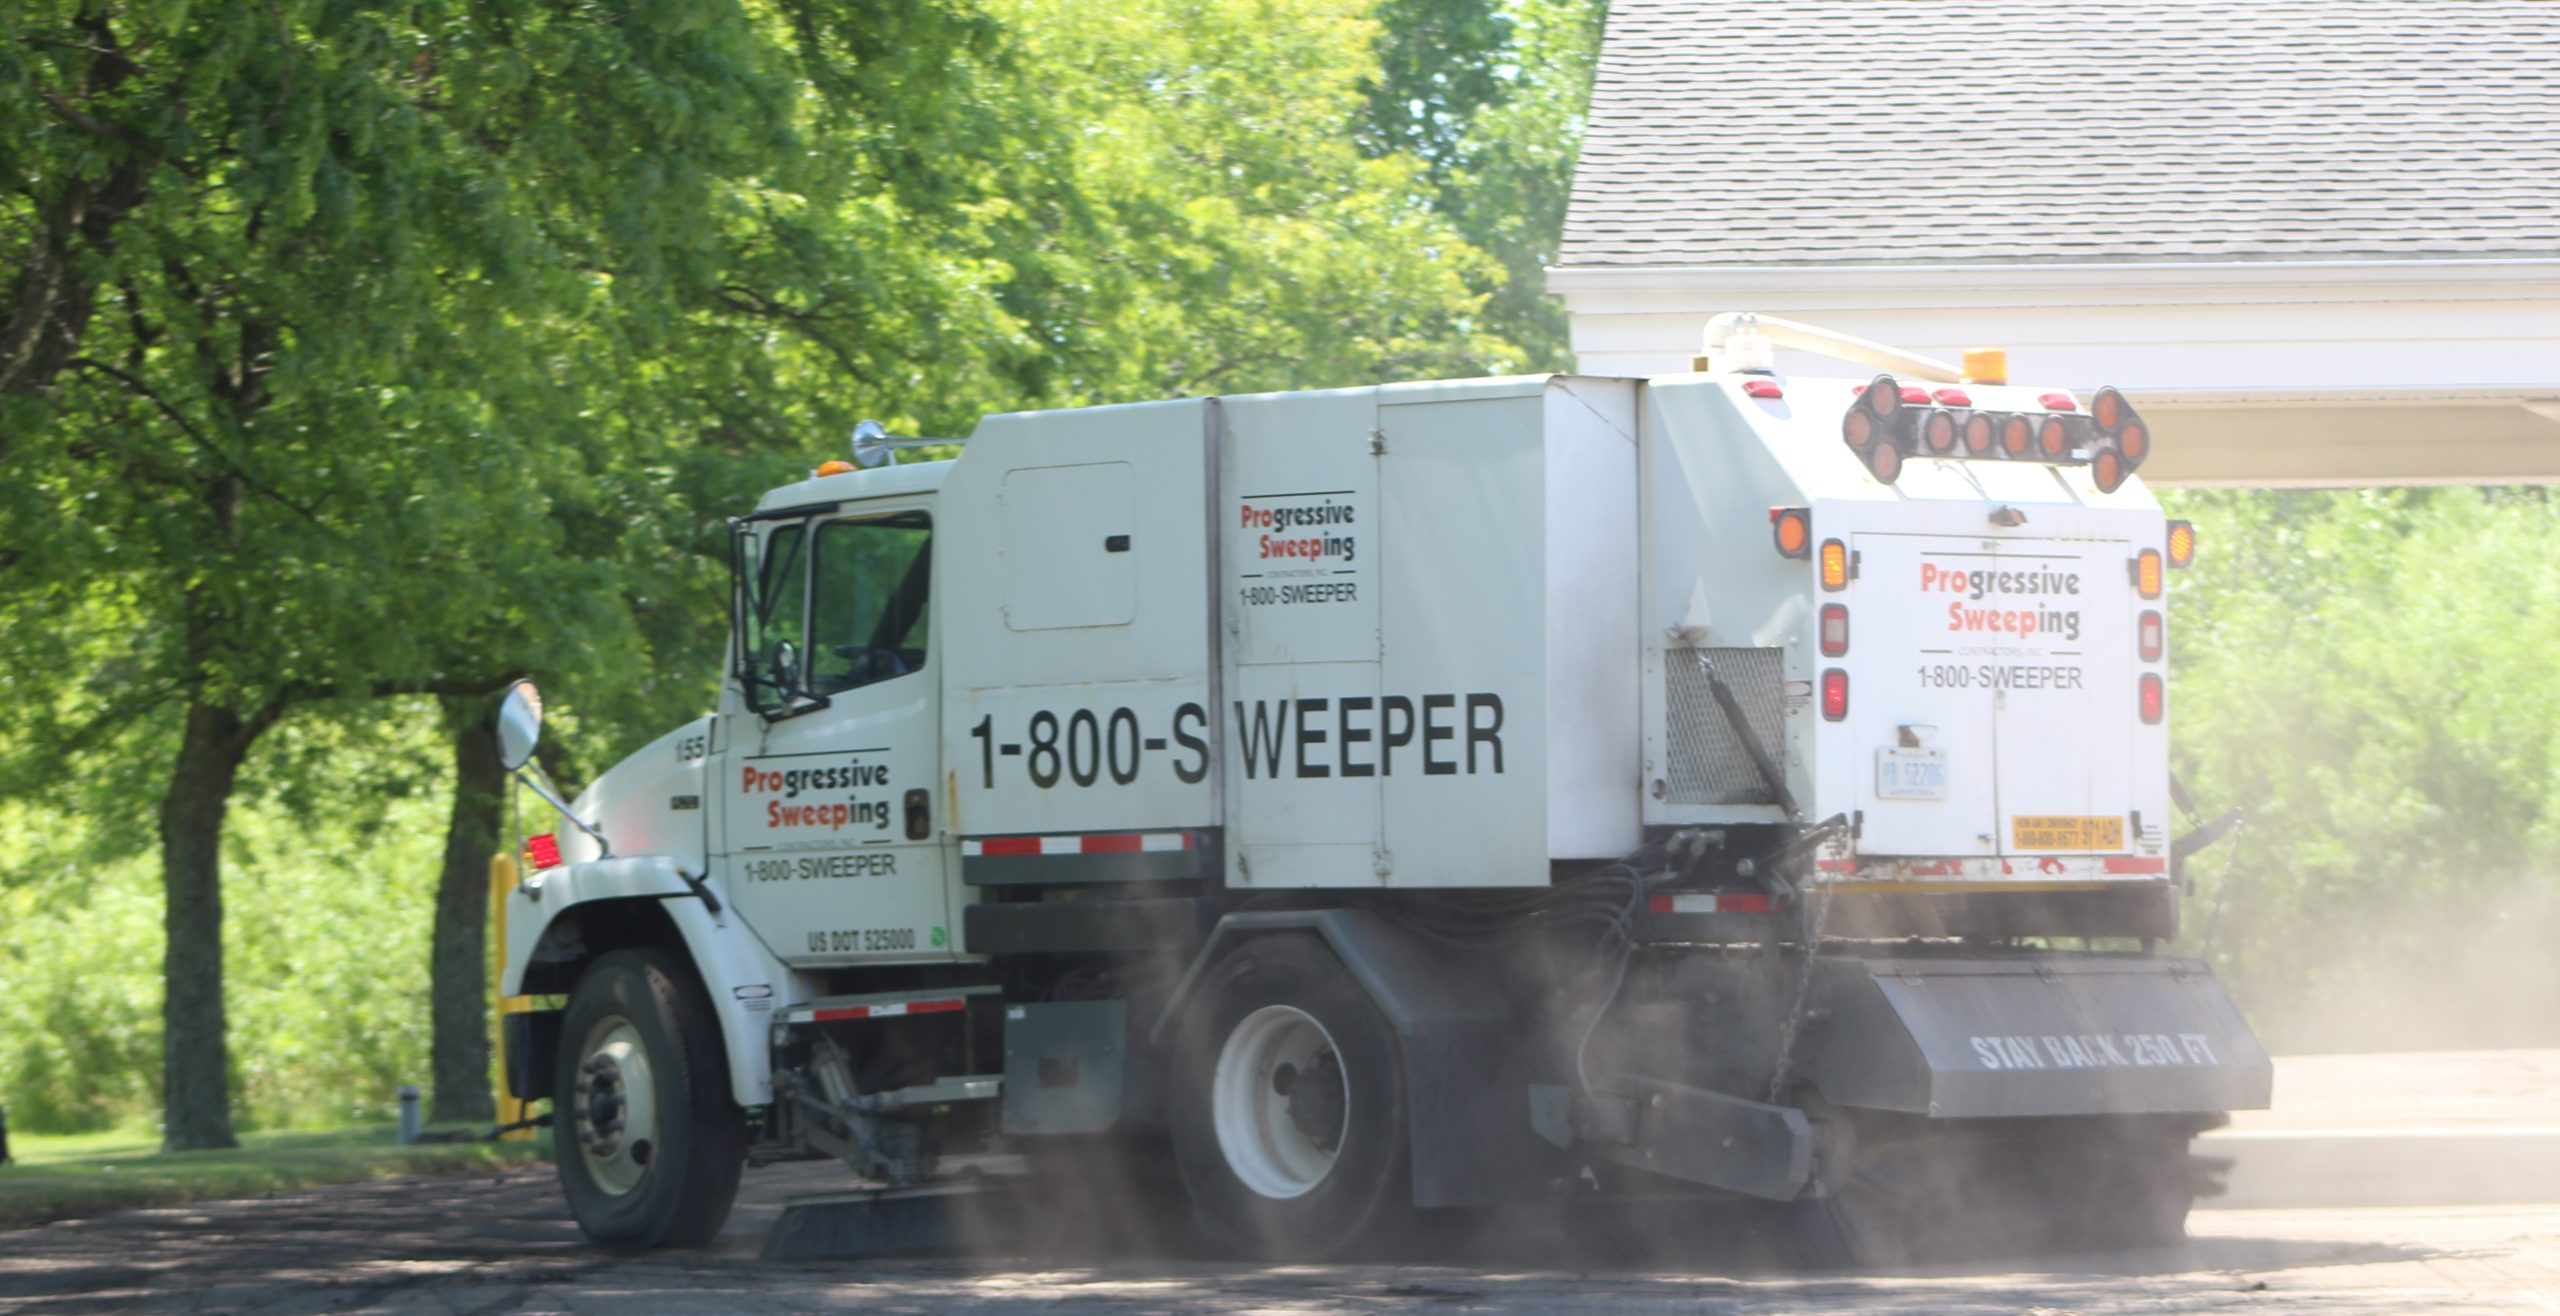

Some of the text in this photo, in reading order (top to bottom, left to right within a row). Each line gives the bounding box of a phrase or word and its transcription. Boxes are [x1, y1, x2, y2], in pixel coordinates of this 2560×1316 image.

[1240, 499, 1355, 533] Progressive
[1259, 531, 1355, 561] Sweeping
[1239, 582, 1357, 606] 1-800-SWEEPER
[1920, 562, 2080, 601] Progressive
[1947, 601, 2080, 641] Sweeping
[1917, 664, 2083, 689] 1-800-SWEEPER
[675, 737, 704, 763] 155
[741, 758, 890, 798] Progressive
[767, 795, 890, 830] Sweeping
[744, 853, 897, 883] 1-800-SWEEPER
[808, 928, 915, 952] US DOT 525000
[1970, 1033, 2218, 1070] STAY BACK 250 FT
